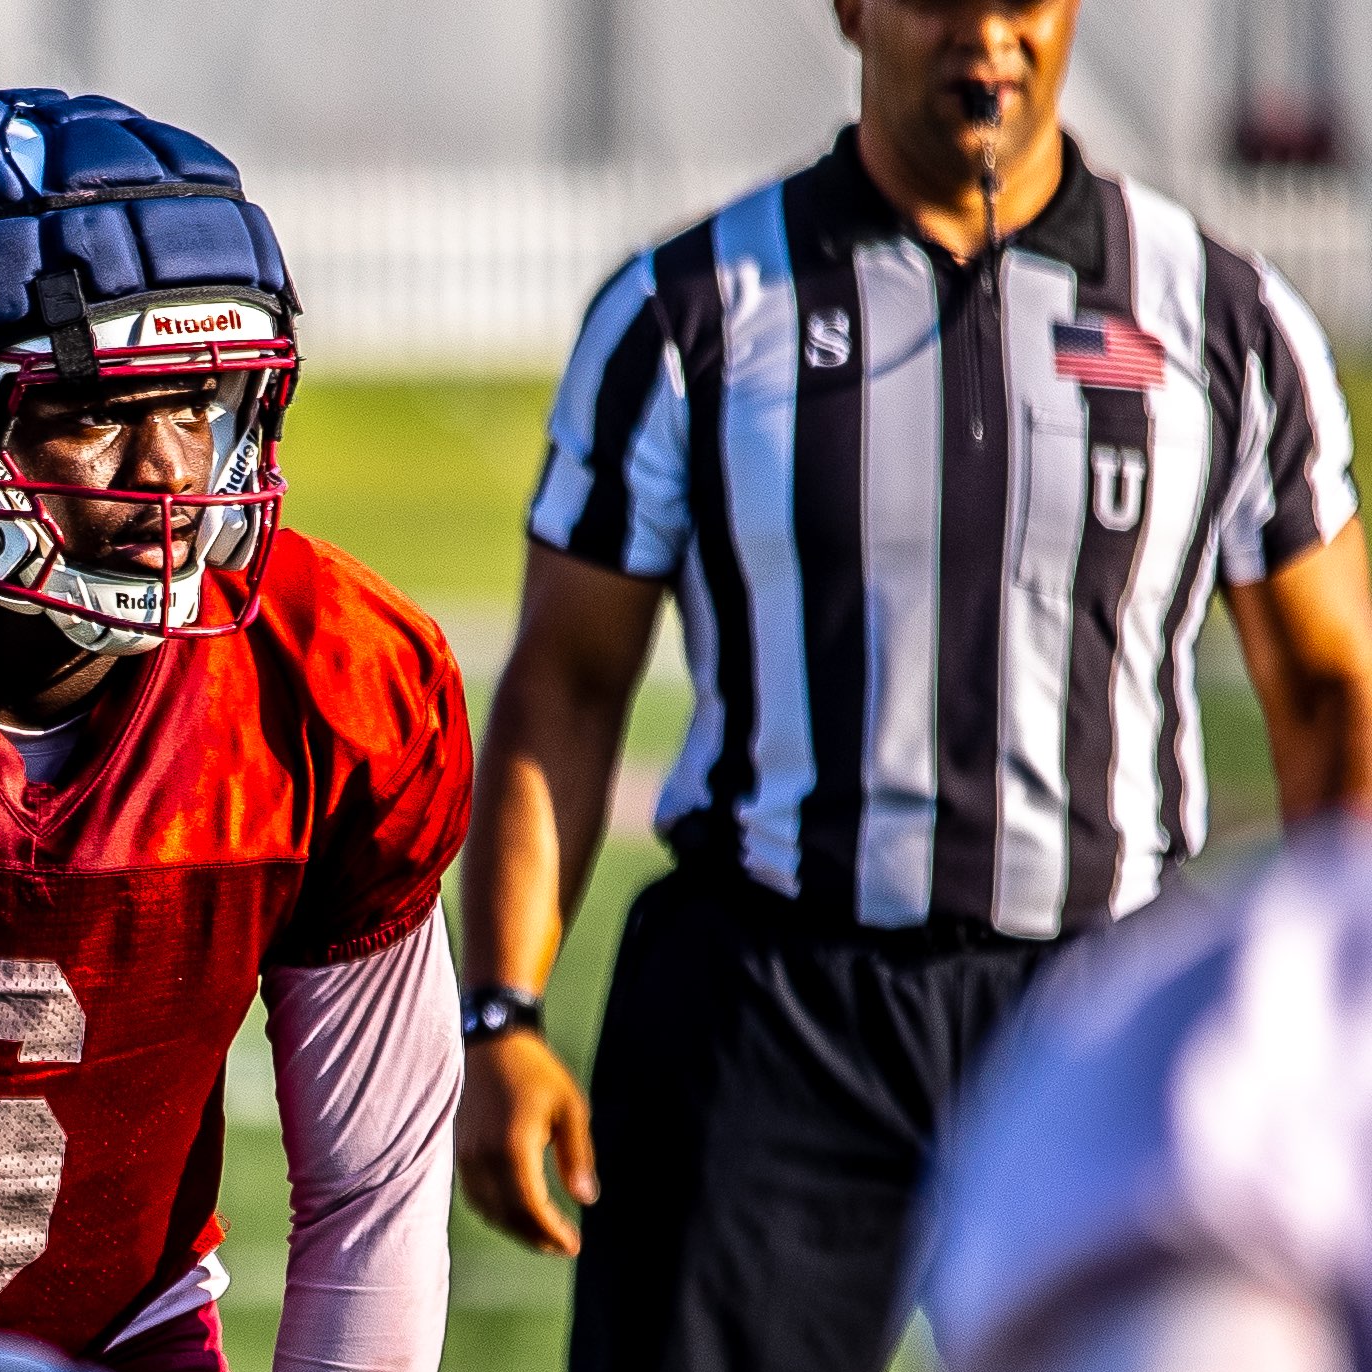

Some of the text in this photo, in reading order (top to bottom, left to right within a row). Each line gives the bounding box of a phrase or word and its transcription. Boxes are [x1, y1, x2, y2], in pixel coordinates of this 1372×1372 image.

[153, 309, 241, 335] Riddell
[1091, 444, 1146, 531] U
[115, 592, 176, 609] Riddll
